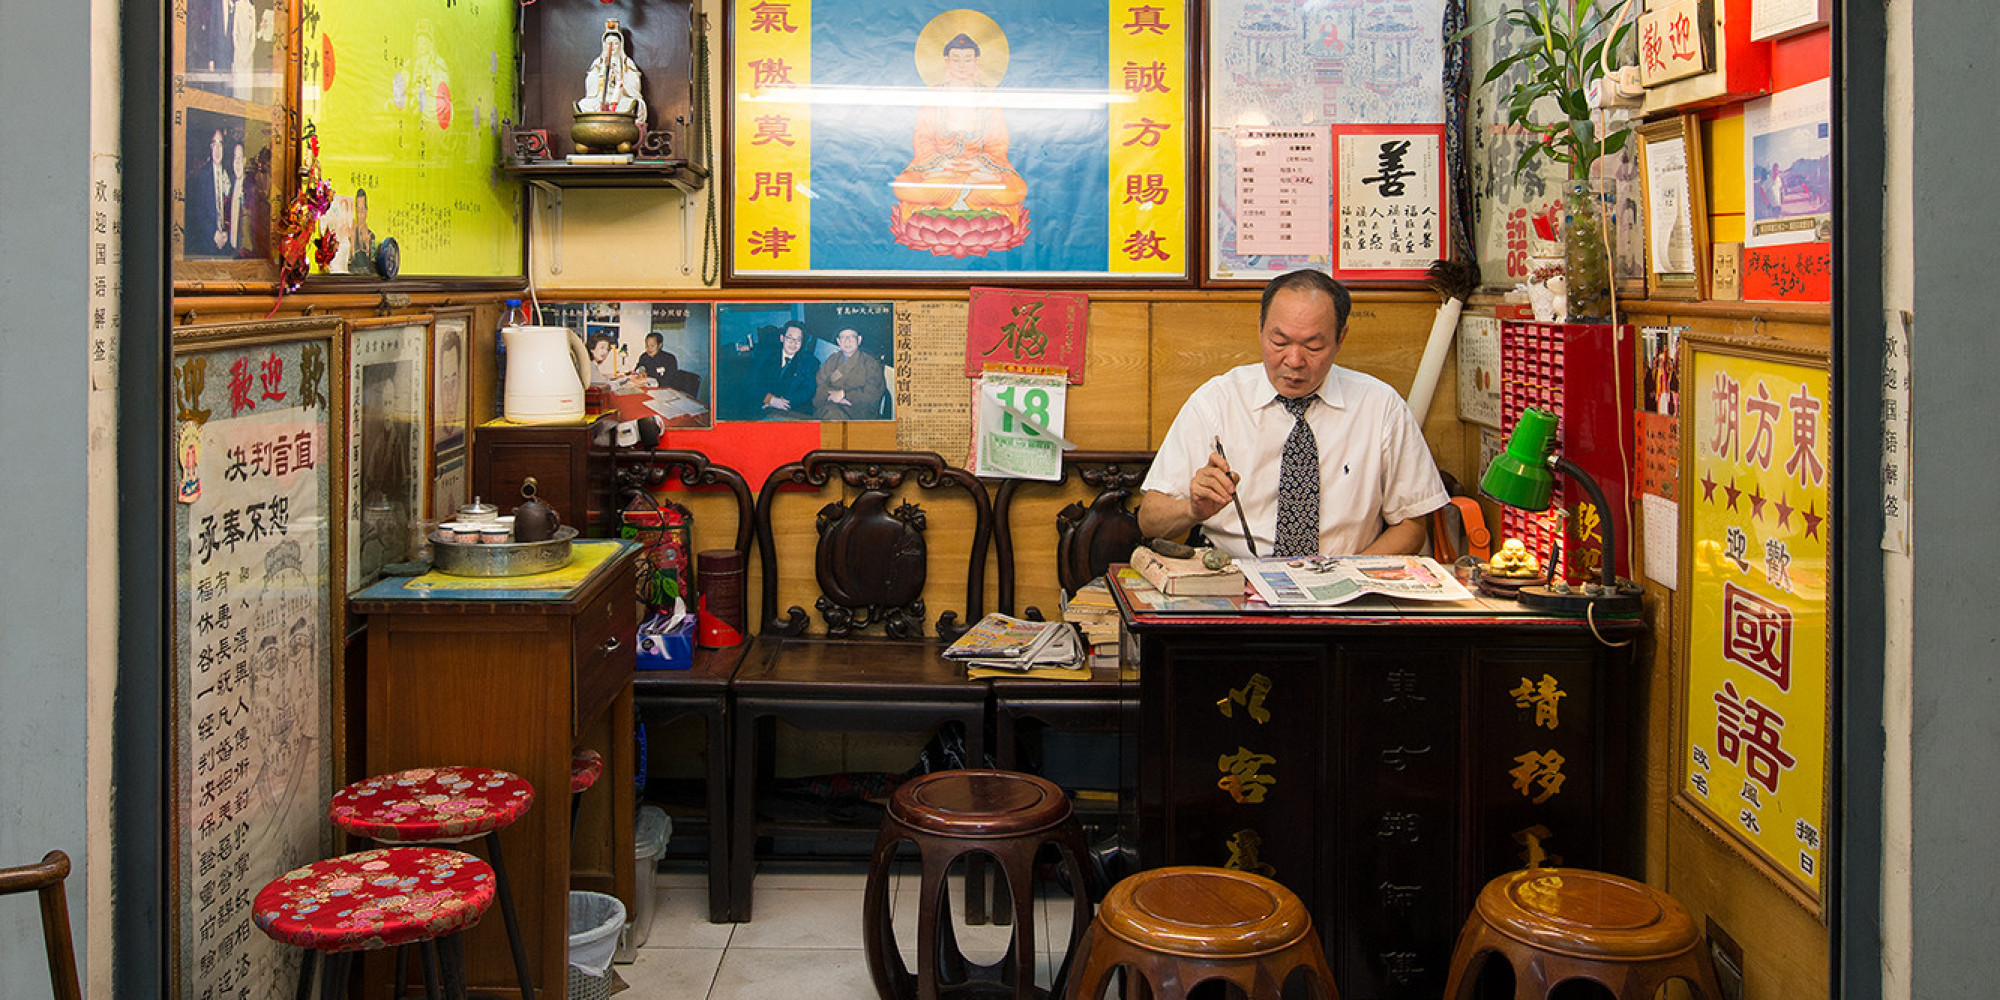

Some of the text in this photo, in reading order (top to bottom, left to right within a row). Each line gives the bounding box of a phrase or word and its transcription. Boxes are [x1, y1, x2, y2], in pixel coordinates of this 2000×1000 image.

[1642, 11, 1696, 78] 歡迎
[747, 1, 798, 259] 氣傲莫問津
[1122, 4, 1171, 262] 真誠方賜教
[1361, 140, 1416, 197] 善
[896, 310, 912, 406] 改運成功的實例
[981, 301, 1049, 360] 福
[228, 352, 287, 418] 歡迎
[996, 386, 1050, 436] 18
[1709, 370, 1825, 488] 東方朔
[1724, 527, 1792, 593] 歡迎
[1714, 581, 1797, 796] 國語
[1690, 746, 1711, 799] 改名
[1740, 780, 1762, 835] 風水
[1796, 818, 1820, 877] 擇日
